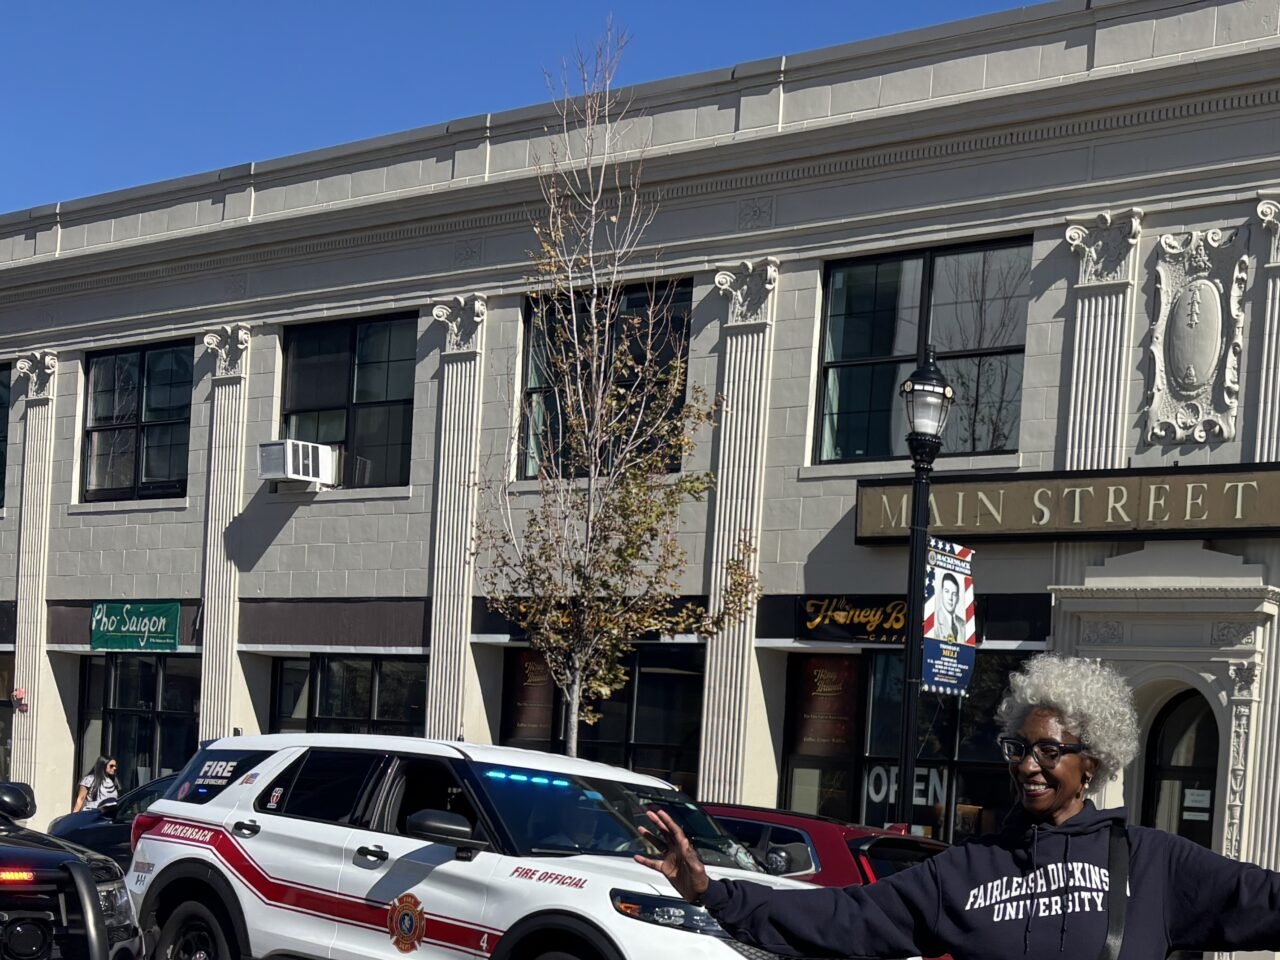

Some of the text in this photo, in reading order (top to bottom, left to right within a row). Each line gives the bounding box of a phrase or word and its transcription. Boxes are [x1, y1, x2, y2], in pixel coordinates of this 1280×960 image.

[879, 489, 1005, 529] MAIN
[1031, 480, 1259, 526] STREET
[121, 604, 166, 646] Saigon
[806, 598, 885, 632] Honey
[199, 761, 238, 777] FIRE
[161, 823, 214, 842] HACKENSACK
[509, 866, 588, 889] FIRE OFFICIAL
[993, 891, 1105, 922] UNIVERSITY
[480, 933, 488, 950] 4
